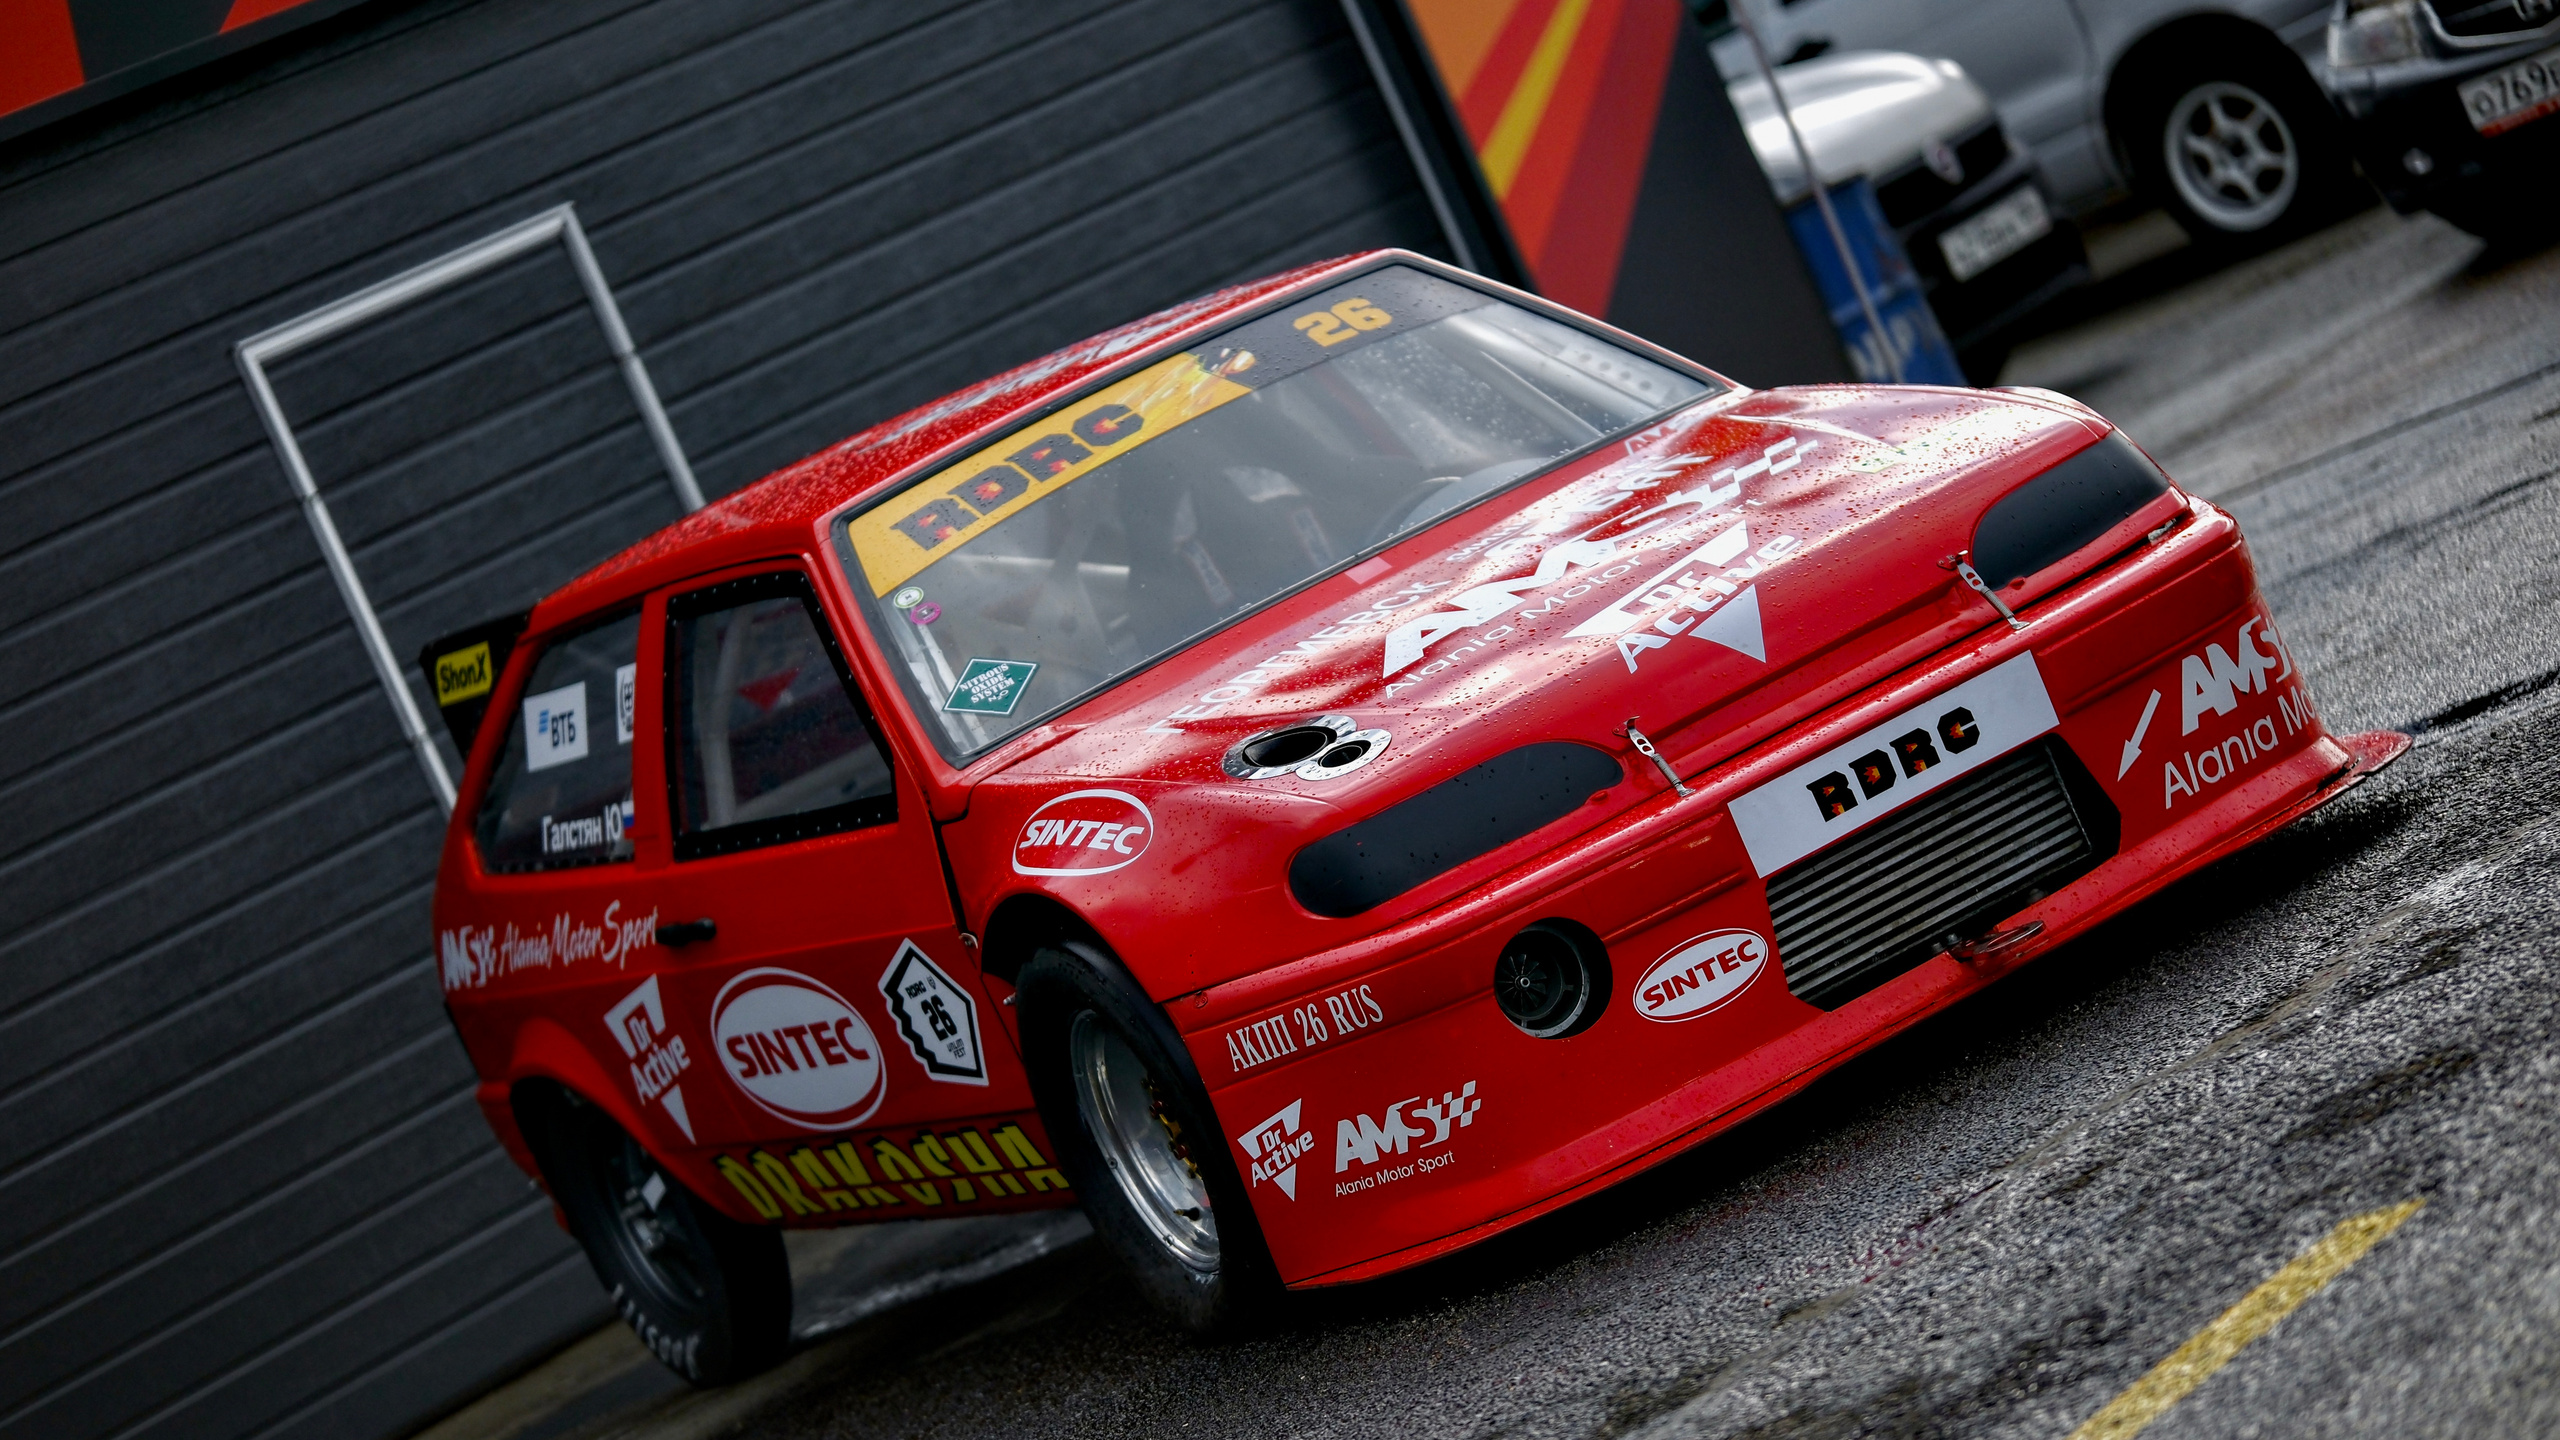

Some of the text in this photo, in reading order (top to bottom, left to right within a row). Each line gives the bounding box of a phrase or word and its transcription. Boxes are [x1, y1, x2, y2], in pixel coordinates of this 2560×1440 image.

[1293, 298, 1393, 347] 26
[890, 403, 1145, 551] RDRC
[1386, 624, 1514, 698] Alania
[1520, 555, 1641, 620] Motor
[1617, 534, 1796, 674] Active
[959, 663, 1009, 692] NITROUS
[970, 678, 1015, 703] SYSTEM
[971, 674, 1007, 694] OXIDE
[551, 709, 576, 748] ВТБ
[1806, 706, 1980, 823] RDRC
[2165, 715, 2279, 810] Alania
[1019, 819, 1145, 854] SINTEC
[498, 921, 551, 976] Alania
[549, 911, 604, 967] Motor
[601, 899, 658, 970] Sport
[1643, 938, 1760, 1010] SINTEC
[921, 994, 957, 1041] 26
[1293, 1003, 1328, 1047] 26
[1325, 984, 1384, 1035] RUS
[630, 1034, 691, 1106] Active
[726, 1017, 871, 1079] SINTEC
[1251, 1130, 1315, 1188] Active
[1262, 1128, 1281, 1153] Dr
[1335, 1150, 1455, 1197] Alania Motor Sport
